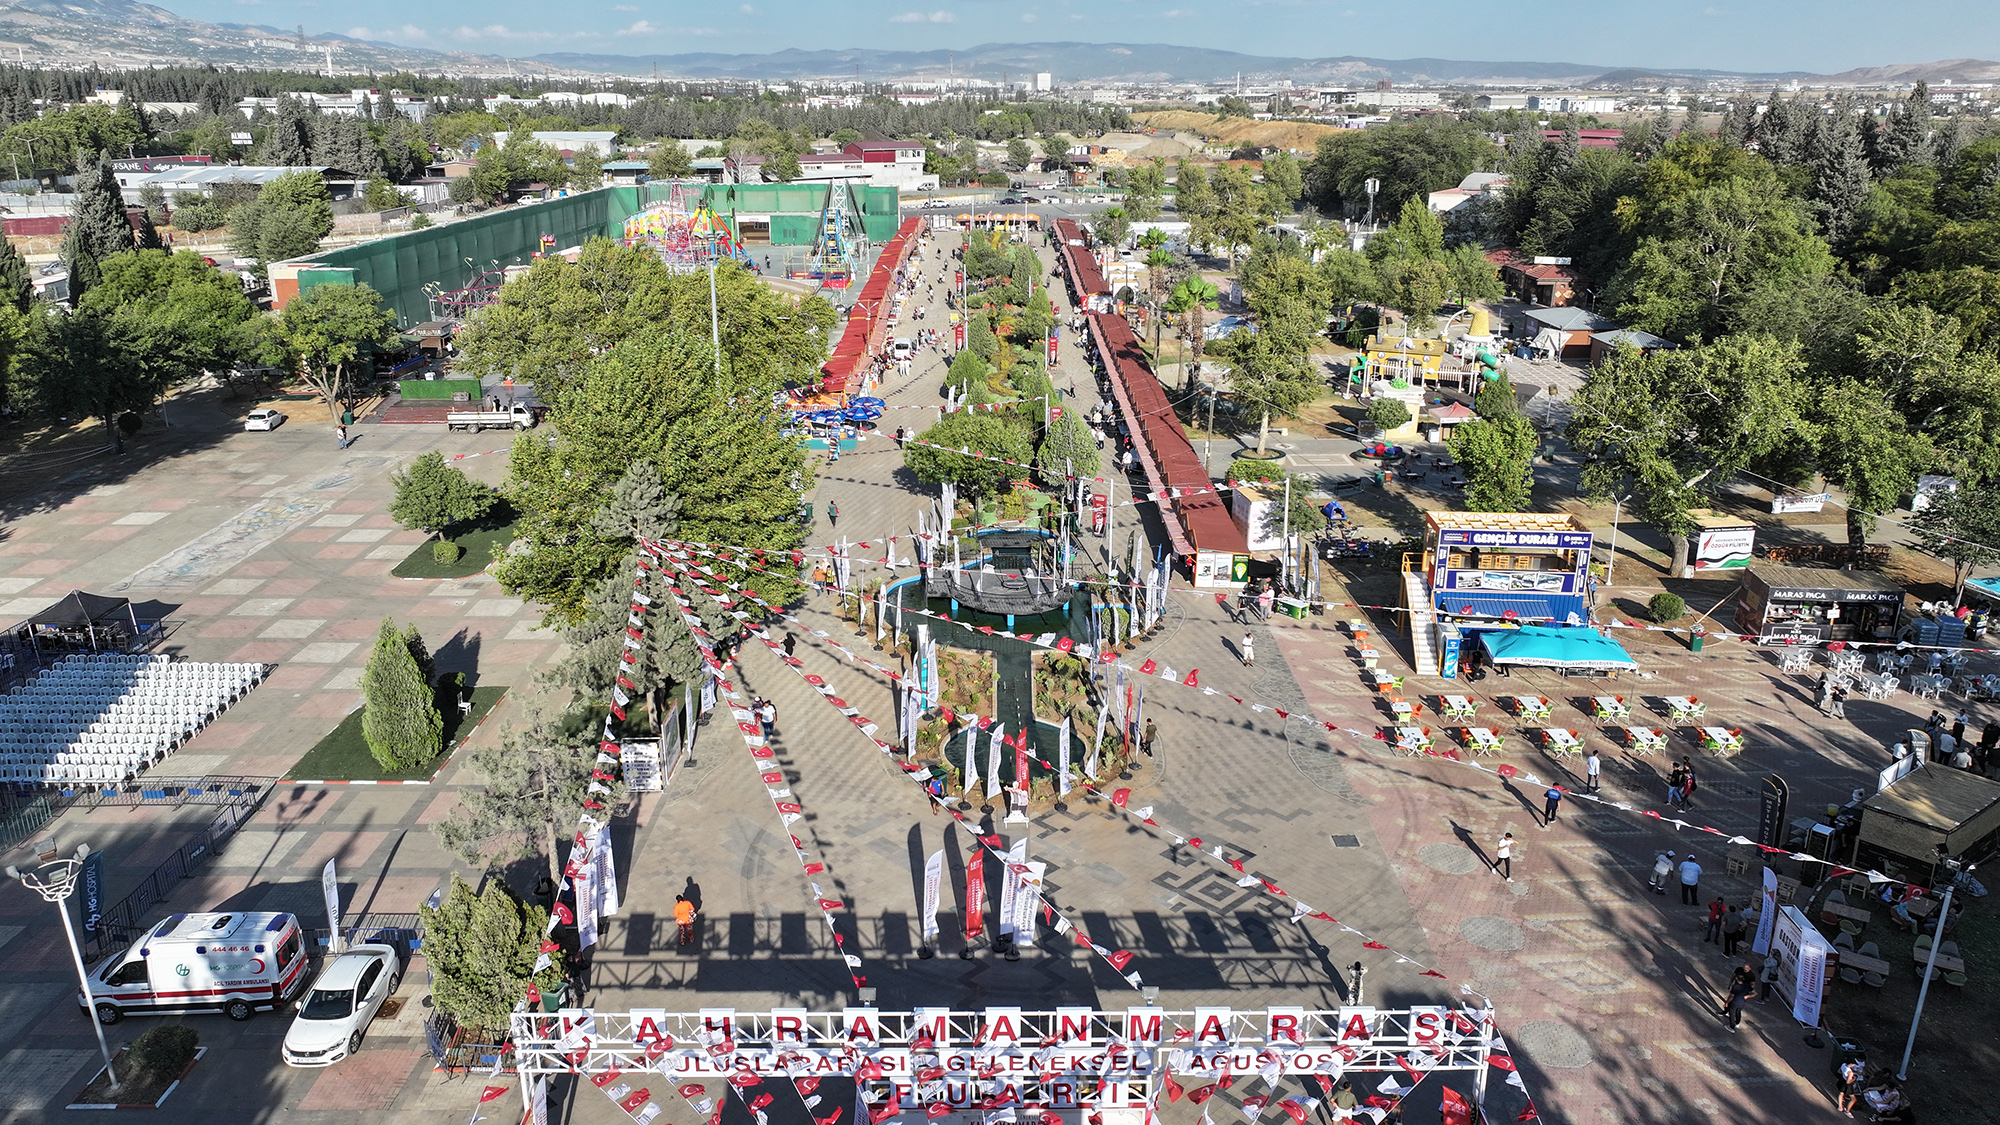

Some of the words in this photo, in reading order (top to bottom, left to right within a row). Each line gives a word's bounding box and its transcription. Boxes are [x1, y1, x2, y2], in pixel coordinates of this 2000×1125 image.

[1473, 532, 1517, 546] GENÇLİK
[1518, 532, 1559, 545] DURAĞI
[225, 979, 242, 987] YARDIM
[1190, 1051, 1336, 1070] AĞUSOS
[895, 1083, 1118, 1104] FUARI
